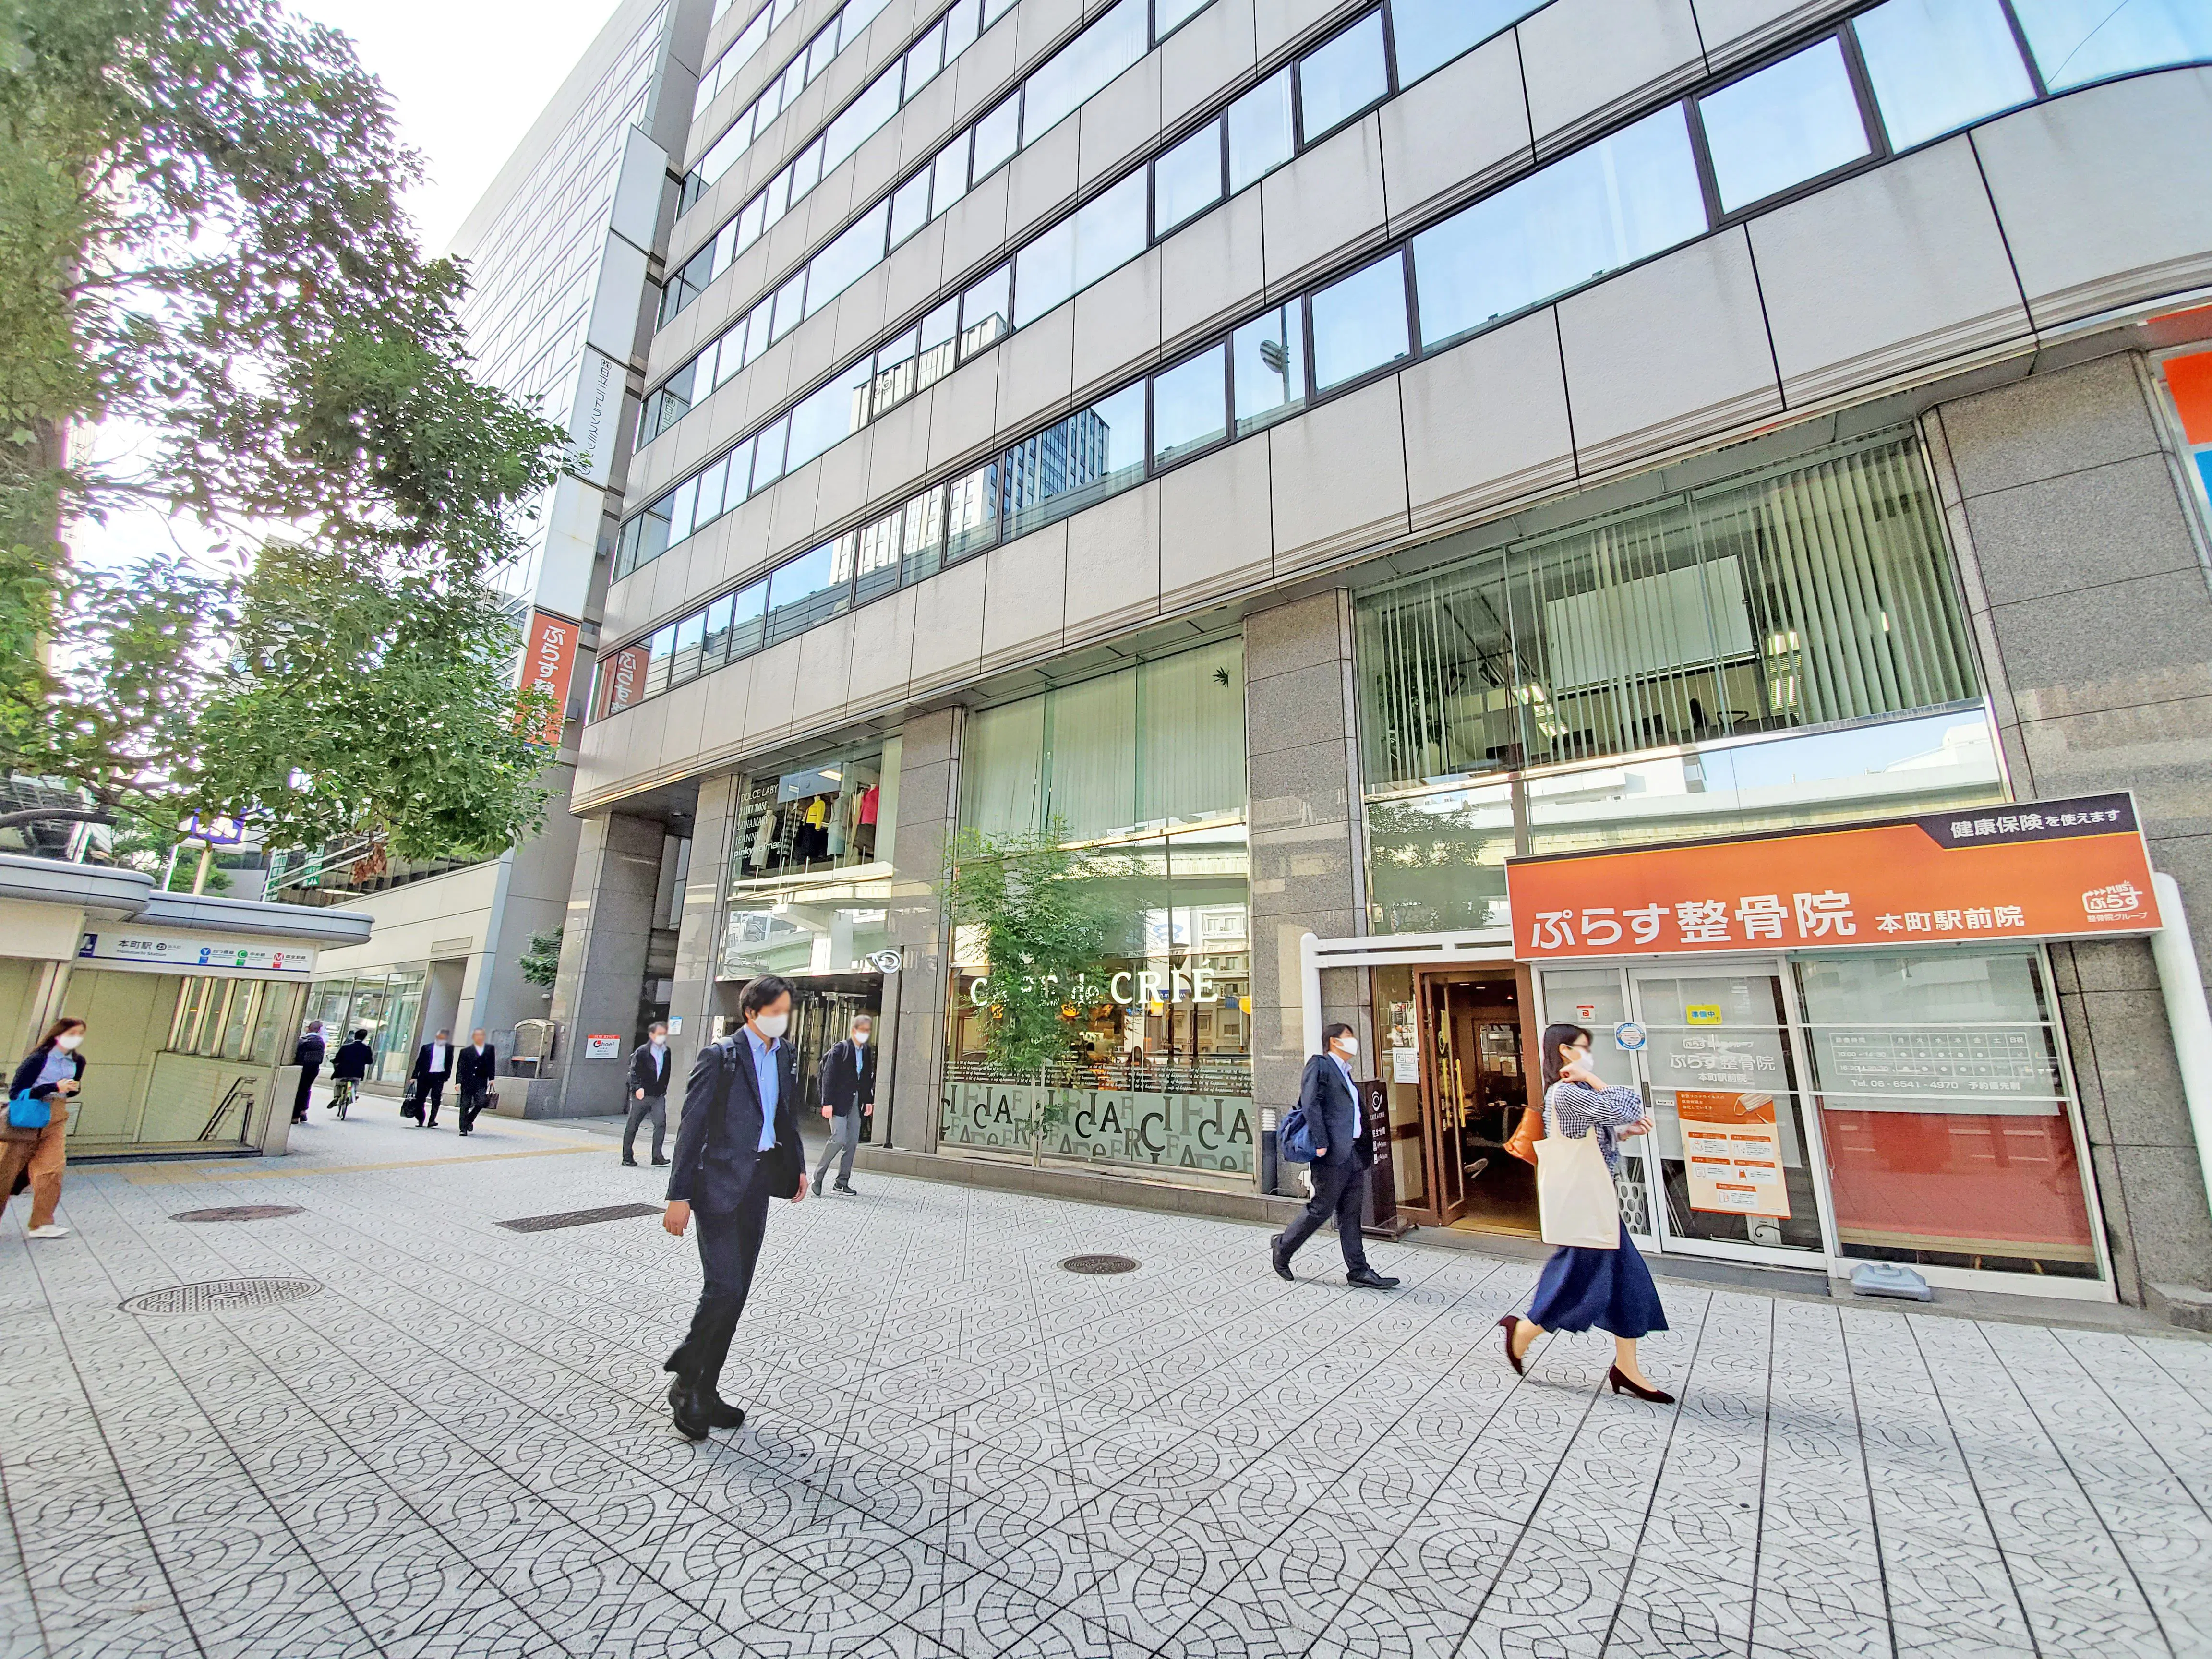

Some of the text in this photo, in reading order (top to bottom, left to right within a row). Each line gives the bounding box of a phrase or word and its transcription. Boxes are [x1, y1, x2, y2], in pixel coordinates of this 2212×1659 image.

[741, 784, 779, 802] DOLCE LABY
[1950, 809, 2121, 838] 健康保険を使えます
[2105, 884, 2129, 894] PLUS
[1531, 890, 2025, 949] ぷらす整骨院 本町駅前院
[2087, 912, 2148, 922] 整骨院グループ
[119, 939, 153, 950] 本町駅
[1110, 958, 1218, 1004] CRIÉ
[1670, 1053, 1776, 1071] ぷらす整骨院
[1698, 1073, 1747, 1082] 本町駅前院
